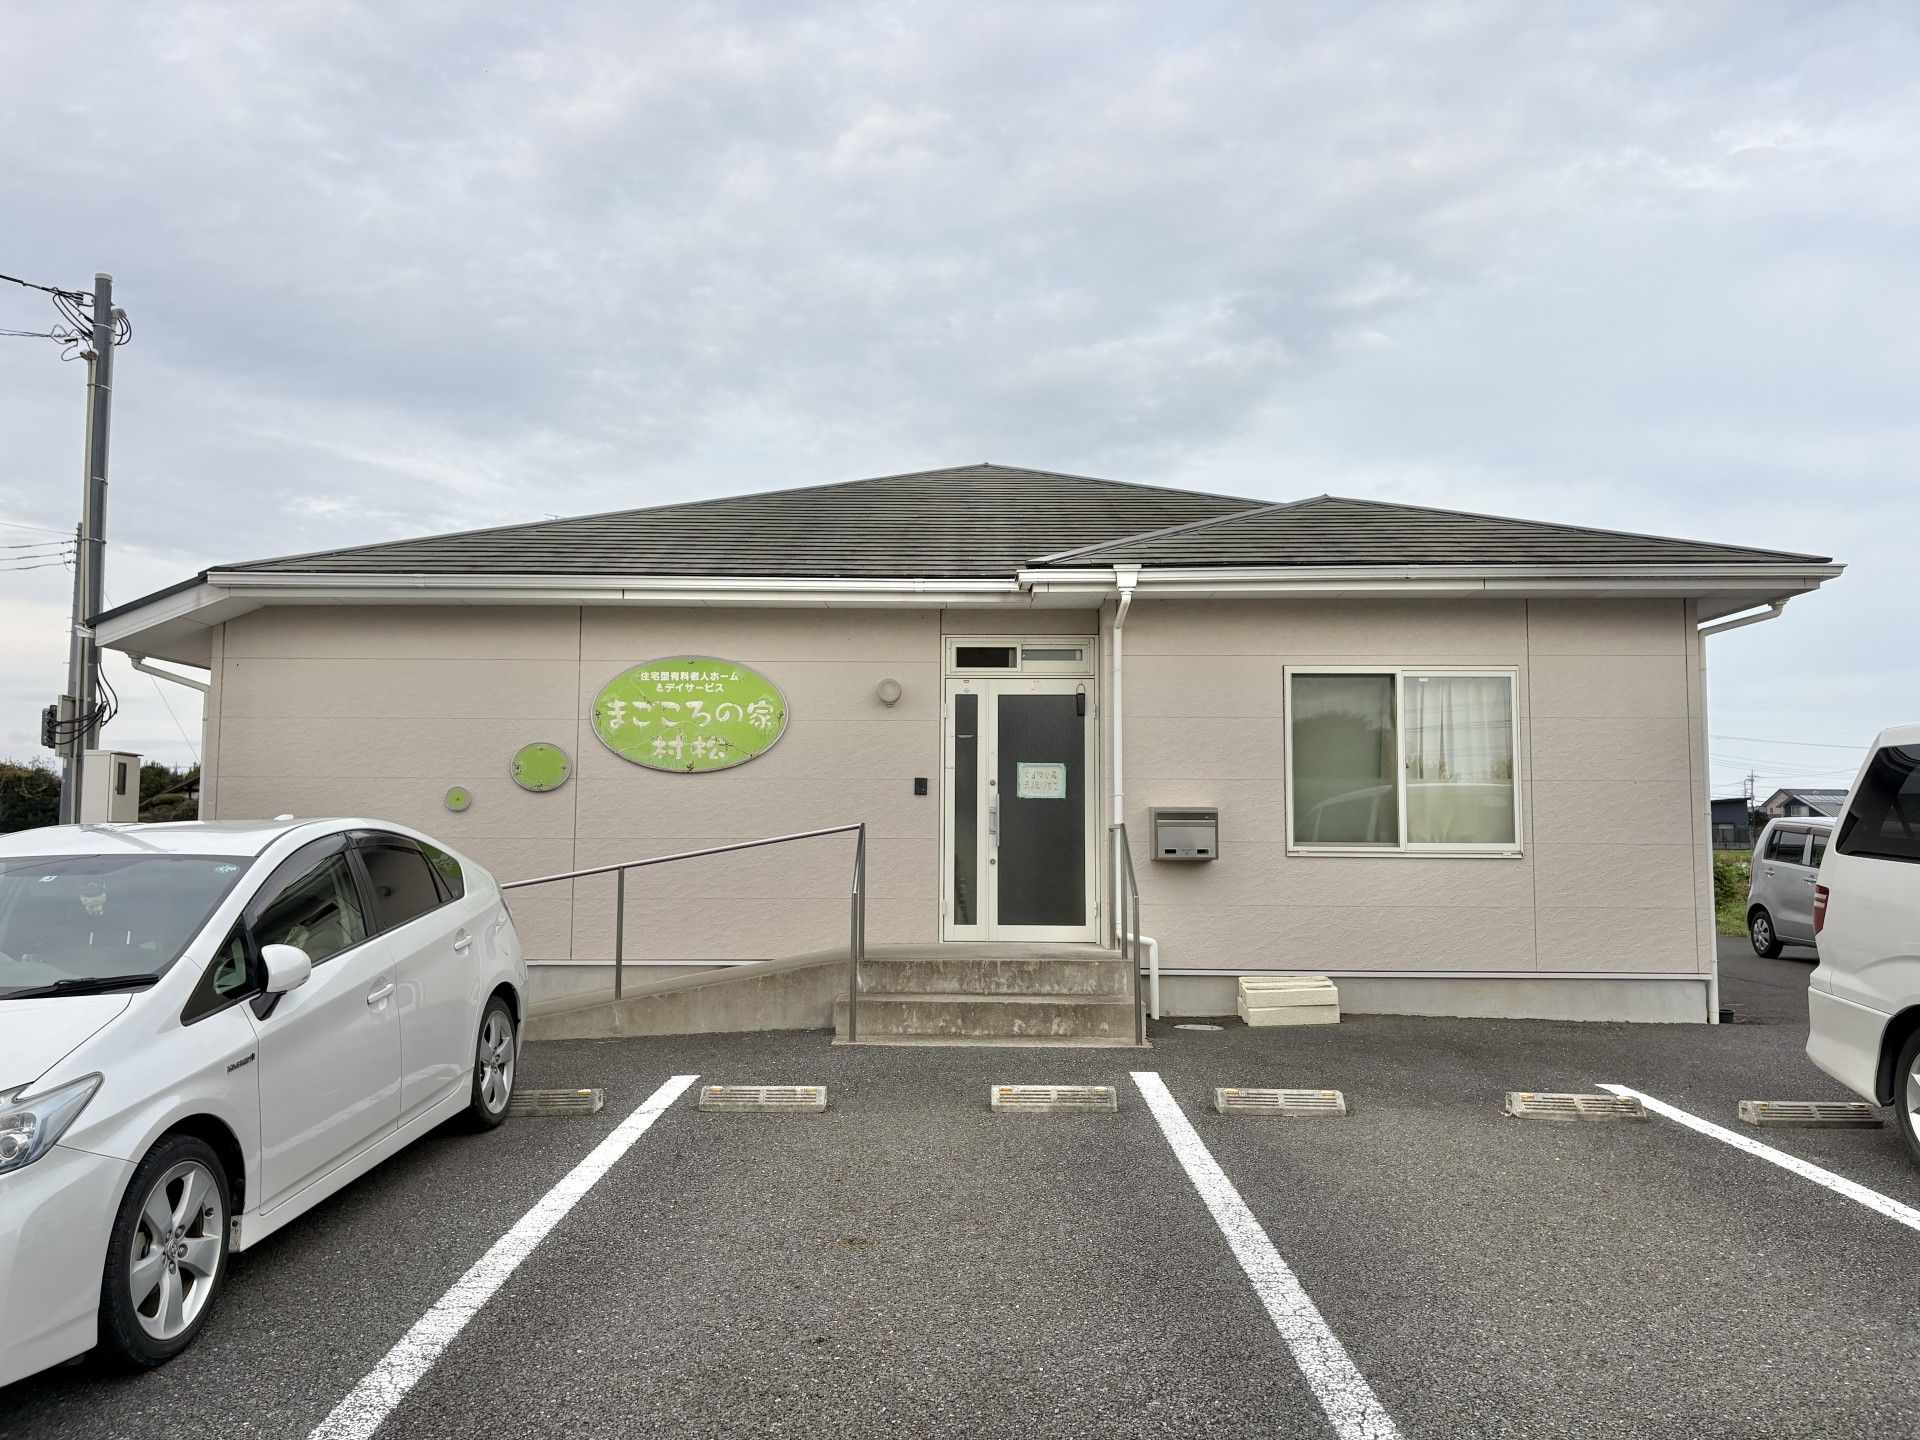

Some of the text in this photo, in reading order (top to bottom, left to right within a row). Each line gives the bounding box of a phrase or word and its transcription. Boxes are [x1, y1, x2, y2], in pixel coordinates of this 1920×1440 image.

[607, 699, 774, 729] まごころの家
